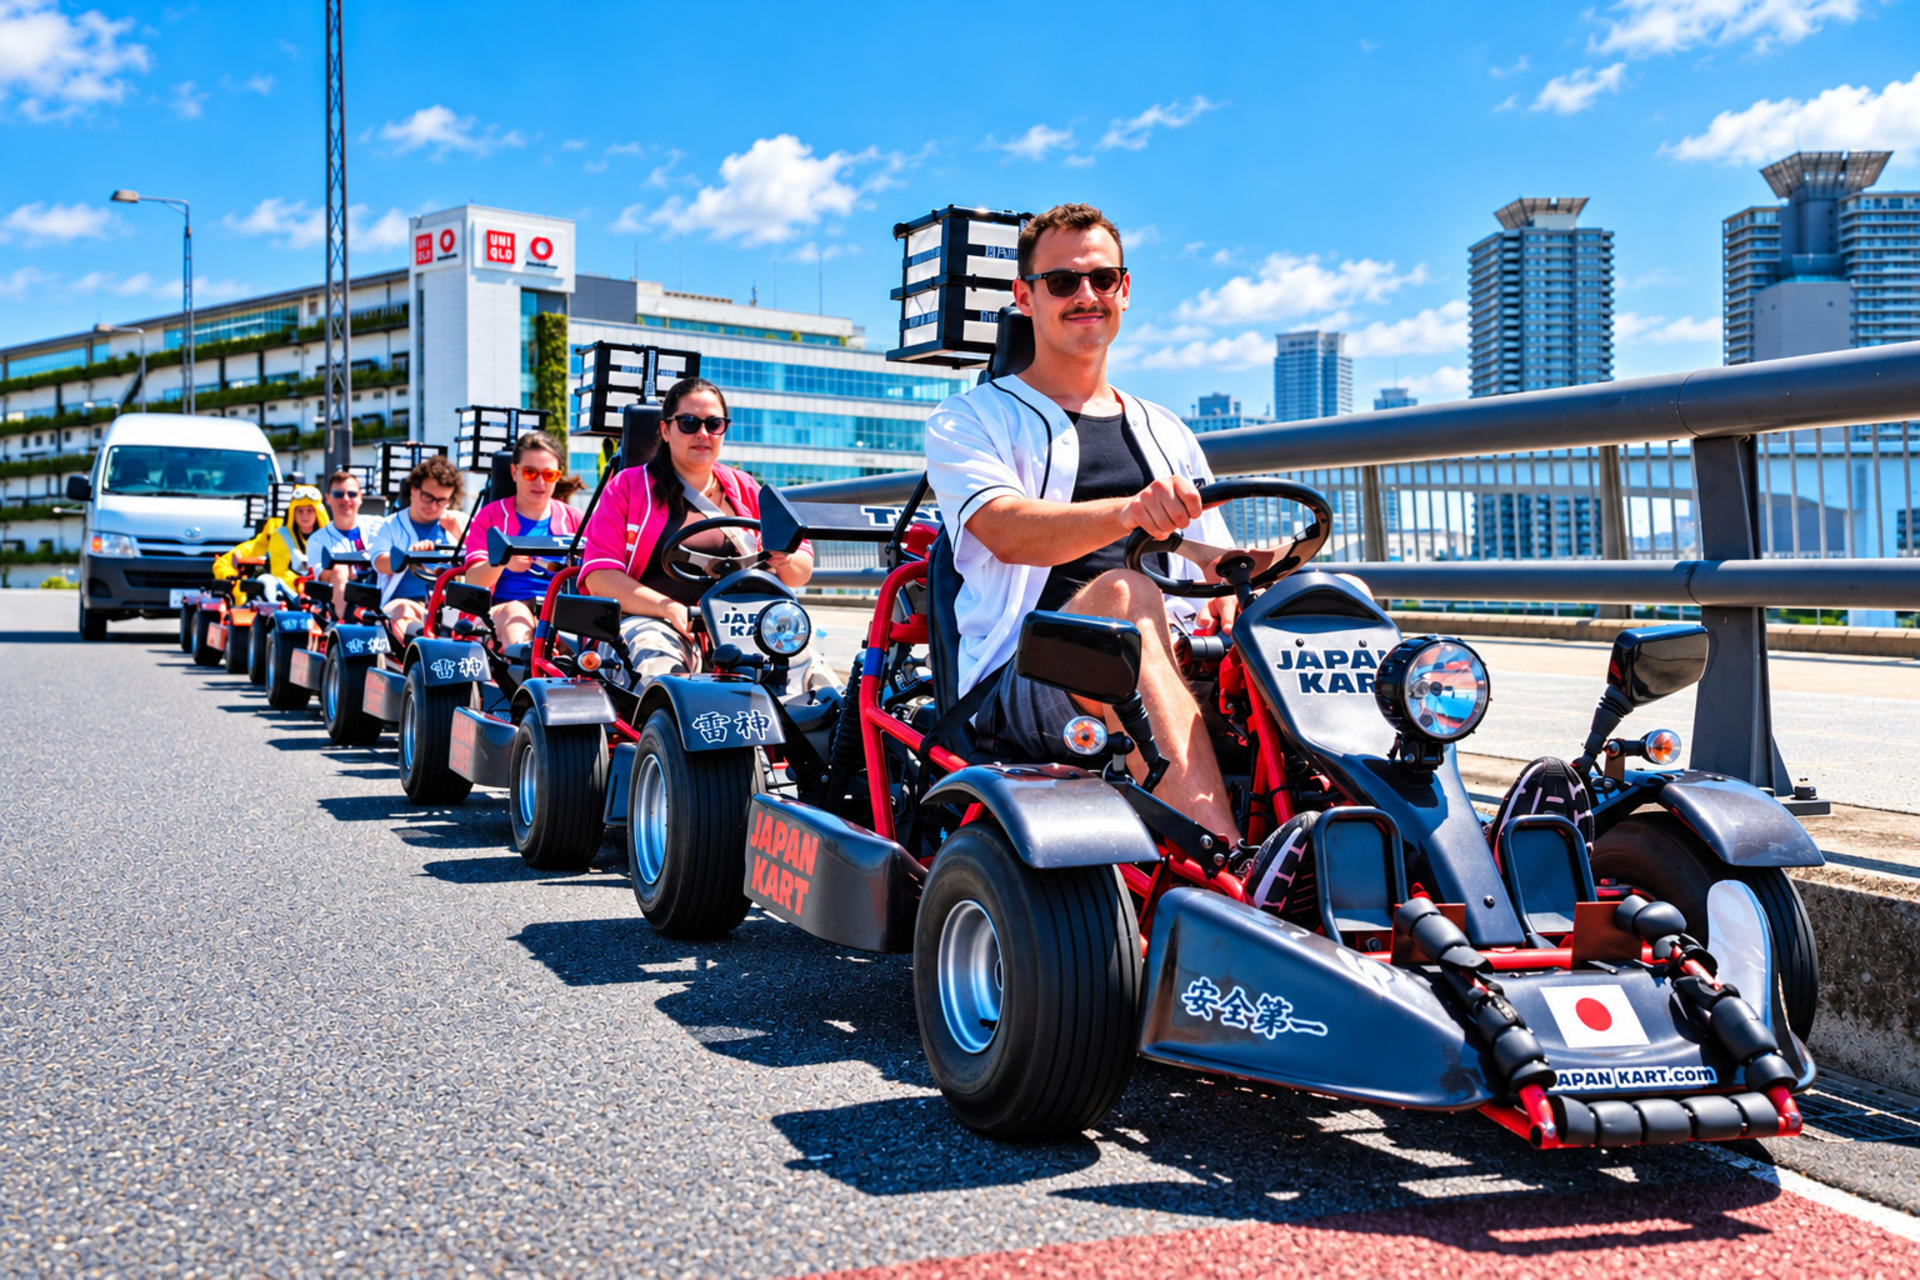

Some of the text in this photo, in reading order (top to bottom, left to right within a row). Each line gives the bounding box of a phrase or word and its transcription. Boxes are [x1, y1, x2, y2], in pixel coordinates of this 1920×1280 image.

[490, 233, 512, 248] UNI
[490, 247, 513, 261] QLO
[1275, 648, 1388, 672] JAPA
[691, 709, 771, 744] 雷神
[750, 810, 819, 877] JAPAN
[751, 855, 811, 917] KART
[1181, 976, 1329, 1040] 安全第一
[1553, 1066, 1718, 1089] APAN KART.com
